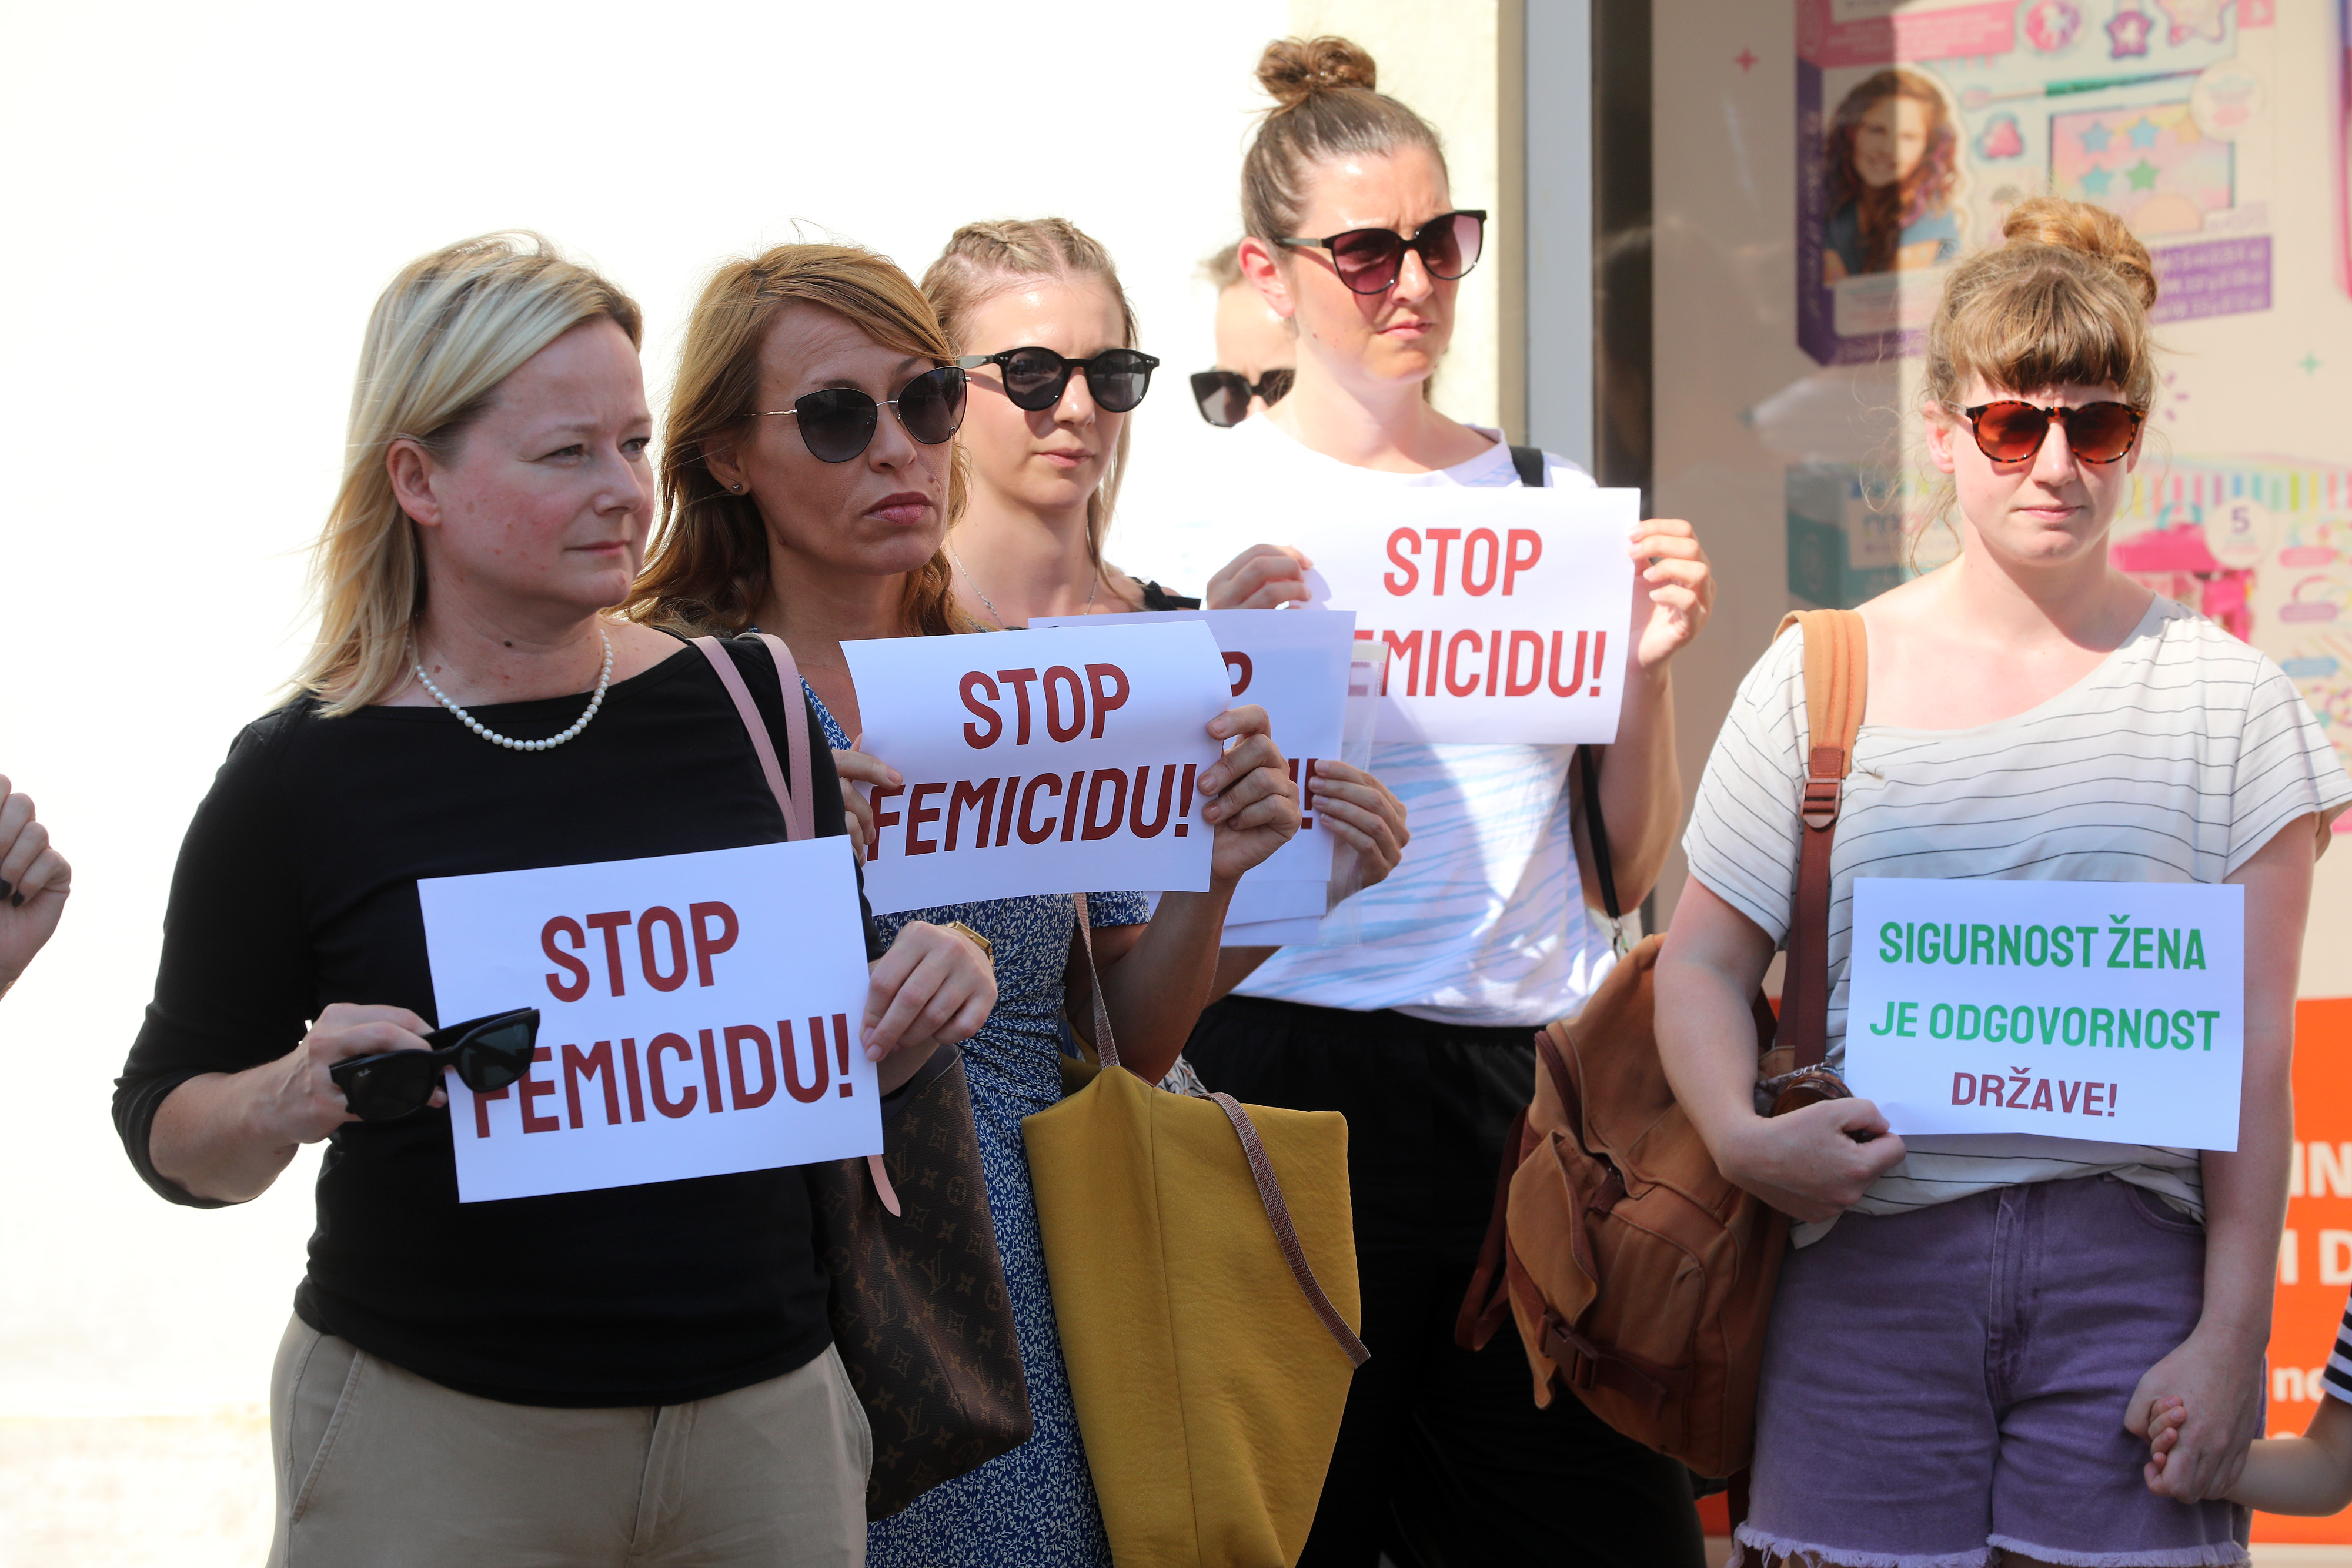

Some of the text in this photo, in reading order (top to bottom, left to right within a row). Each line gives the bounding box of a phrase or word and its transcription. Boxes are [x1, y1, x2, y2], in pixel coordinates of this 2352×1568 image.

[1384, 527, 1542, 597] STOP
[1348, 630, 1606, 697] MICIDU!
[959, 663, 1130, 750] STOP
[867, 763, 1197, 861] FEMICIDU!
[540, 901, 739, 1002] STOP
[1879, 915, 2206, 970] SIGURNOST ŽENA
[1869, 1001, 2220, 1051] JE ODGOVORNOST
[1951, 1066, 2118, 1118] DRŽAVE!
